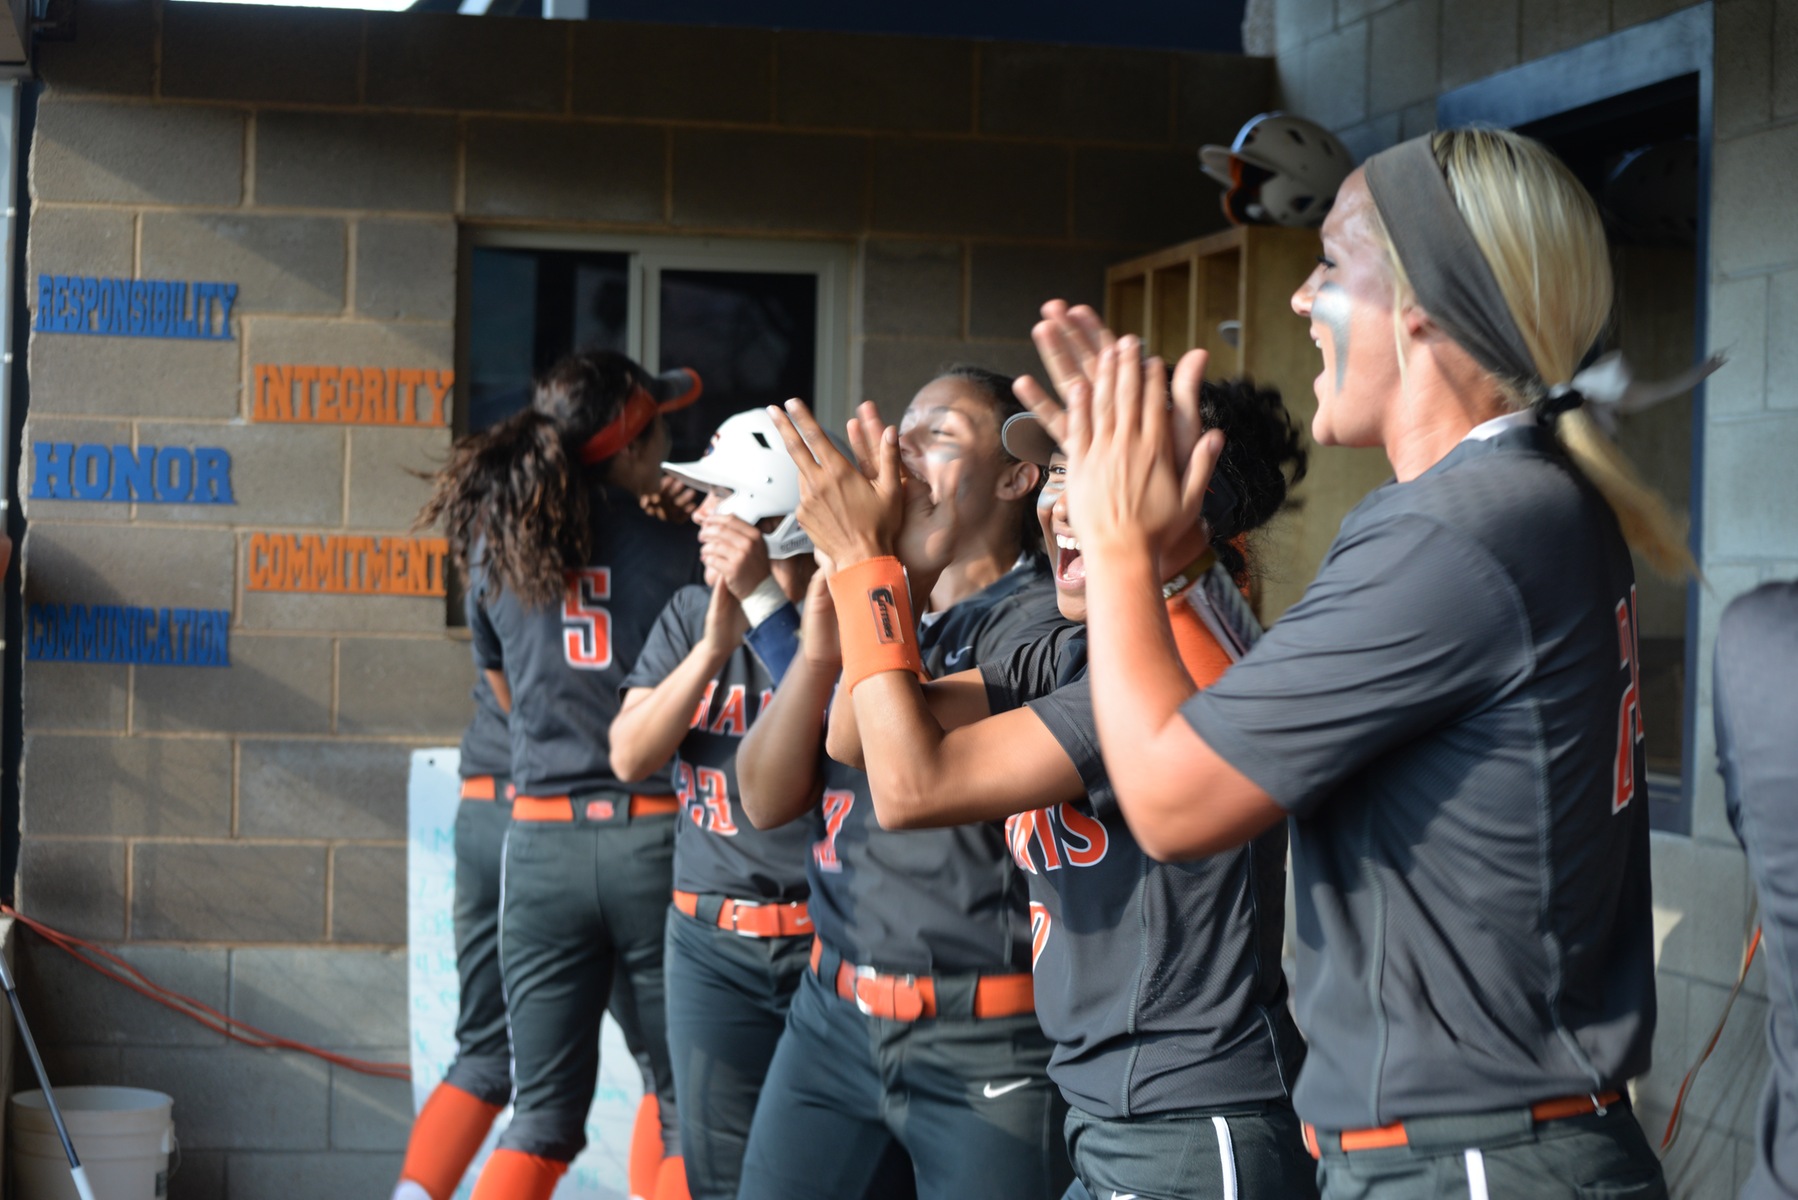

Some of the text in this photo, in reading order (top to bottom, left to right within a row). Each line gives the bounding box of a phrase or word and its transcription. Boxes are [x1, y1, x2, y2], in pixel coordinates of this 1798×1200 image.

[34, 274, 238, 341] RESPONSIBILITY
[253, 364, 455, 428] INTEGRITY
[29, 441, 236, 505] HONOR
[247, 533, 449, 596] COMMITMENT
[27, 603, 231, 667] COMMUNICATION
[562, 566, 612, 670] 5
